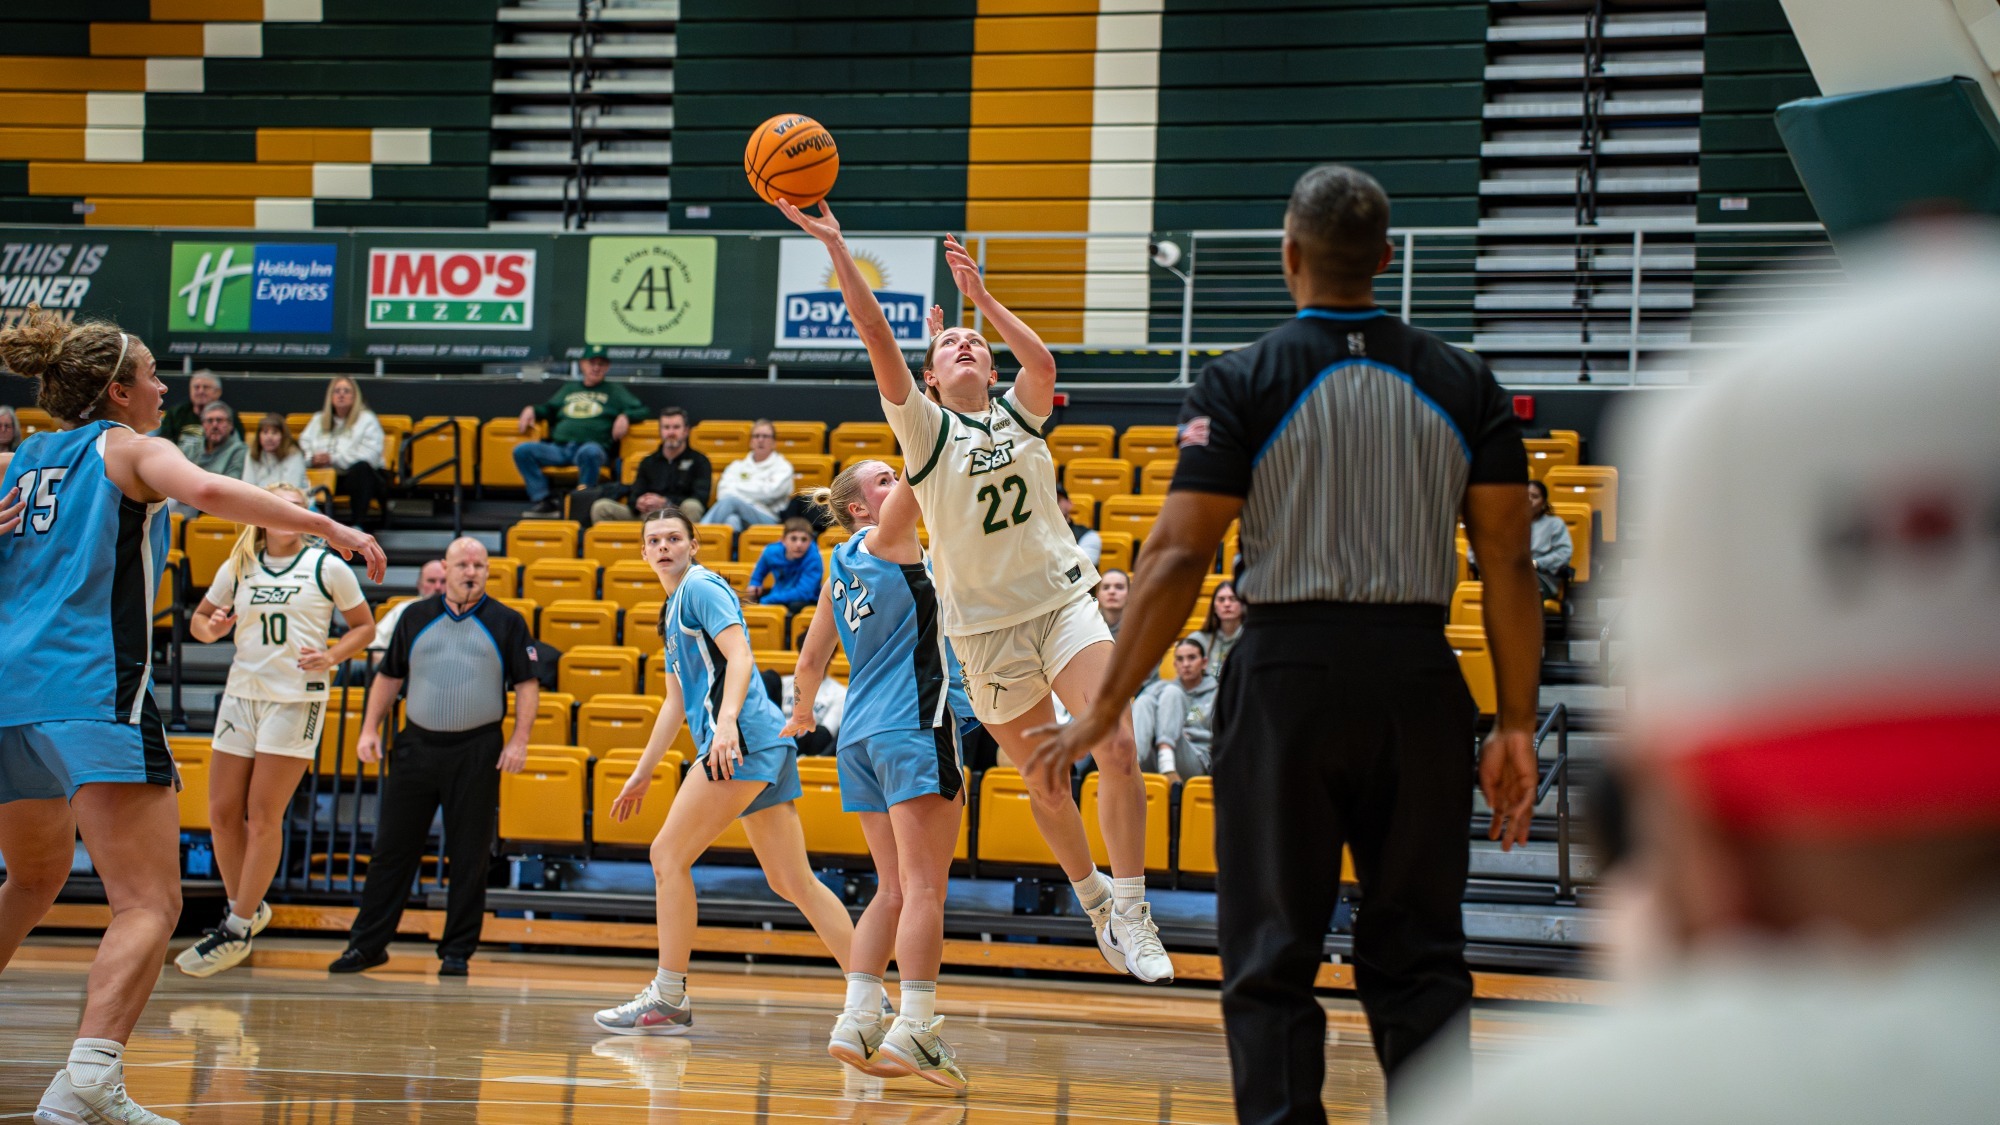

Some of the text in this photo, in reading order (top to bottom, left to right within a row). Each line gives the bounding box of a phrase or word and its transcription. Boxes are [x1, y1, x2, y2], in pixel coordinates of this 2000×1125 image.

[1, 243, 109, 275] THIS IS
[257, 259, 333, 280] Holiday Inn
[0, 275, 91, 308] MINER
[256, 277, 329, 305] Express
[371, 254, 527, 297] IMO'S
[623, 266, 677, 311] AH
[375, 302, 519, 321] PIZZA
[880, 301, 918, 322] nn
[799, 325, 820, 338] BY
[969, 440, 1014, 476] S&T
[14, 466, 69, 537] 15
[977, 474, 1032, 534] 22
[250, 586, 301, 605] S&T
[833, 573, 875, 634] 22
[260, 613, 287, 645] 10
